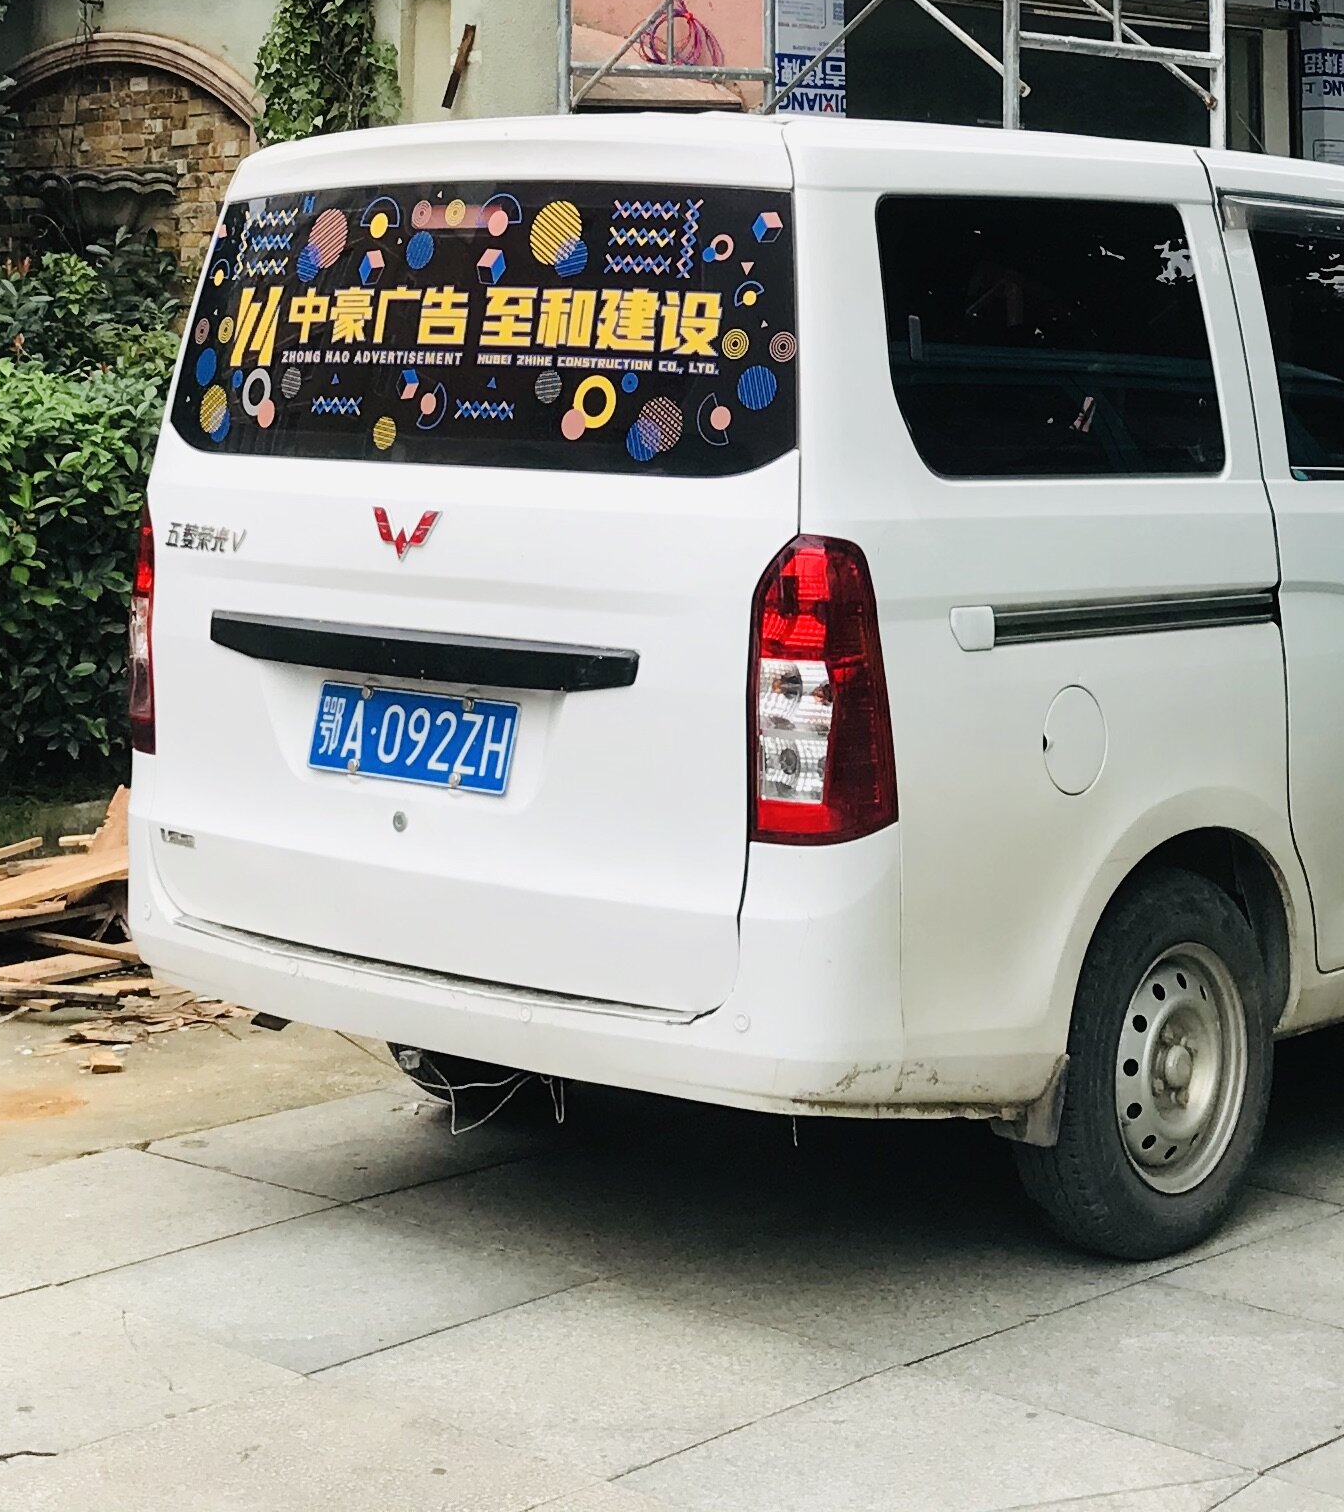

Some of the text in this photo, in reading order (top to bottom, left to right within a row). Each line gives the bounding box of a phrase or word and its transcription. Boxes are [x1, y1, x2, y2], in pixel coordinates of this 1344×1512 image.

[288, 285, 723, 356] 中豪广告 至和建设
[281, 350, 463, 366] ZHONG HAO ADVERTISEMENT
[476, 353, 513, 366] HUBEI
[516, 354, 553, 367] ZHIHE
[556, 356, 653, 372] CONSTRUCTION
